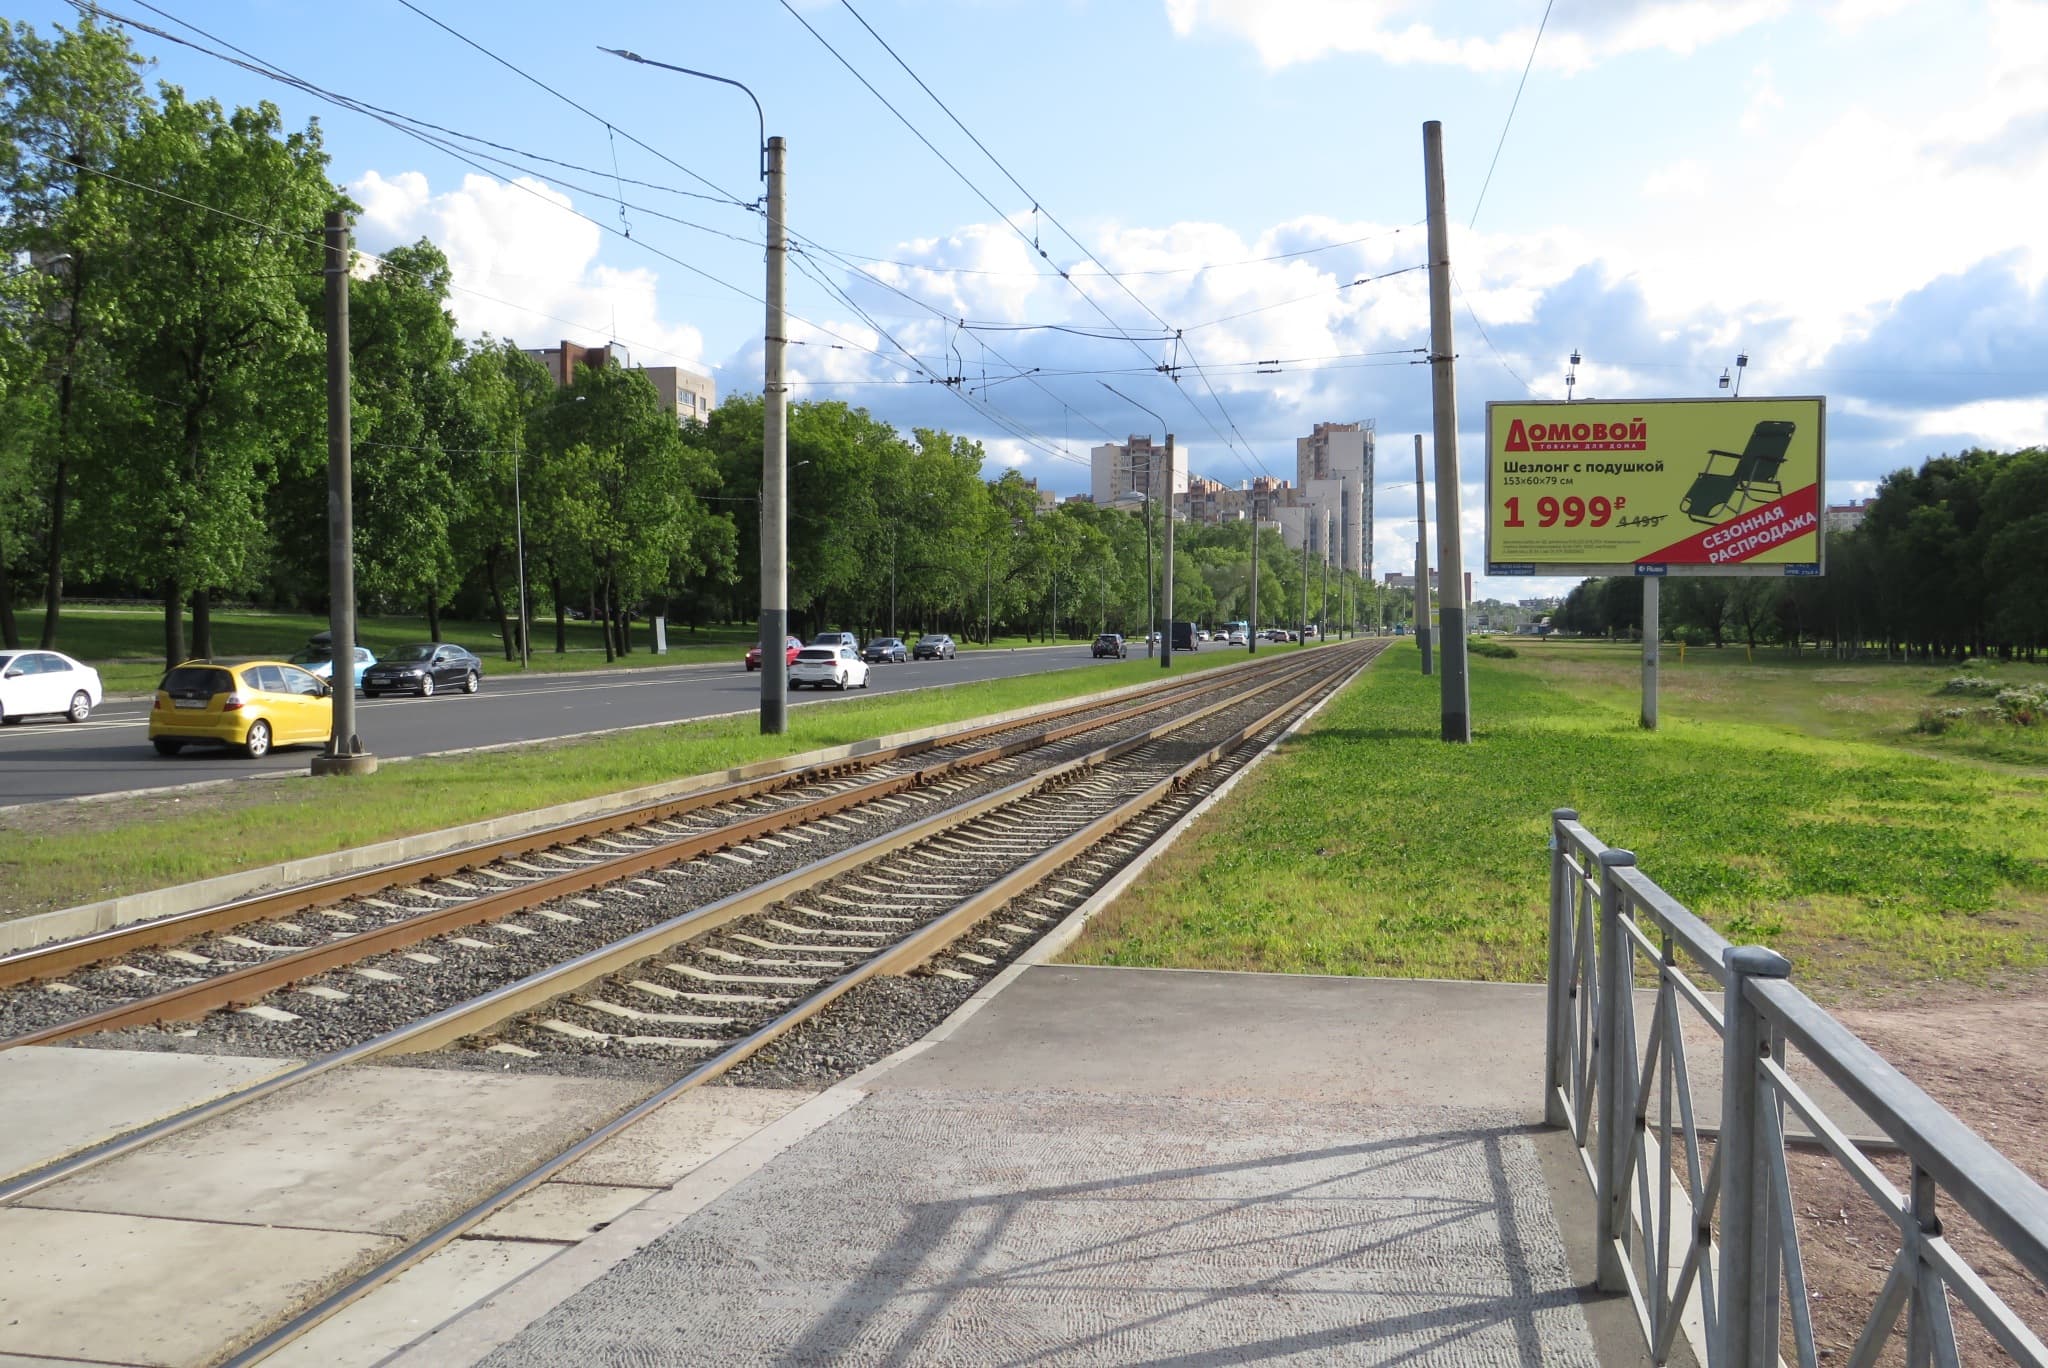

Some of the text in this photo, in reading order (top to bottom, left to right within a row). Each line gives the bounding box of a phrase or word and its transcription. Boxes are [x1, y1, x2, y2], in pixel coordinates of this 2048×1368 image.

[1504, 460, 1664, 475] Шезлонг с подушкой
[1504, 496, 1525, 528] 1
[1702, 506, 1785, 549] СЕЗОННАЯ
[1708, 511, 1816, 563] РАСПРОДАЖА
